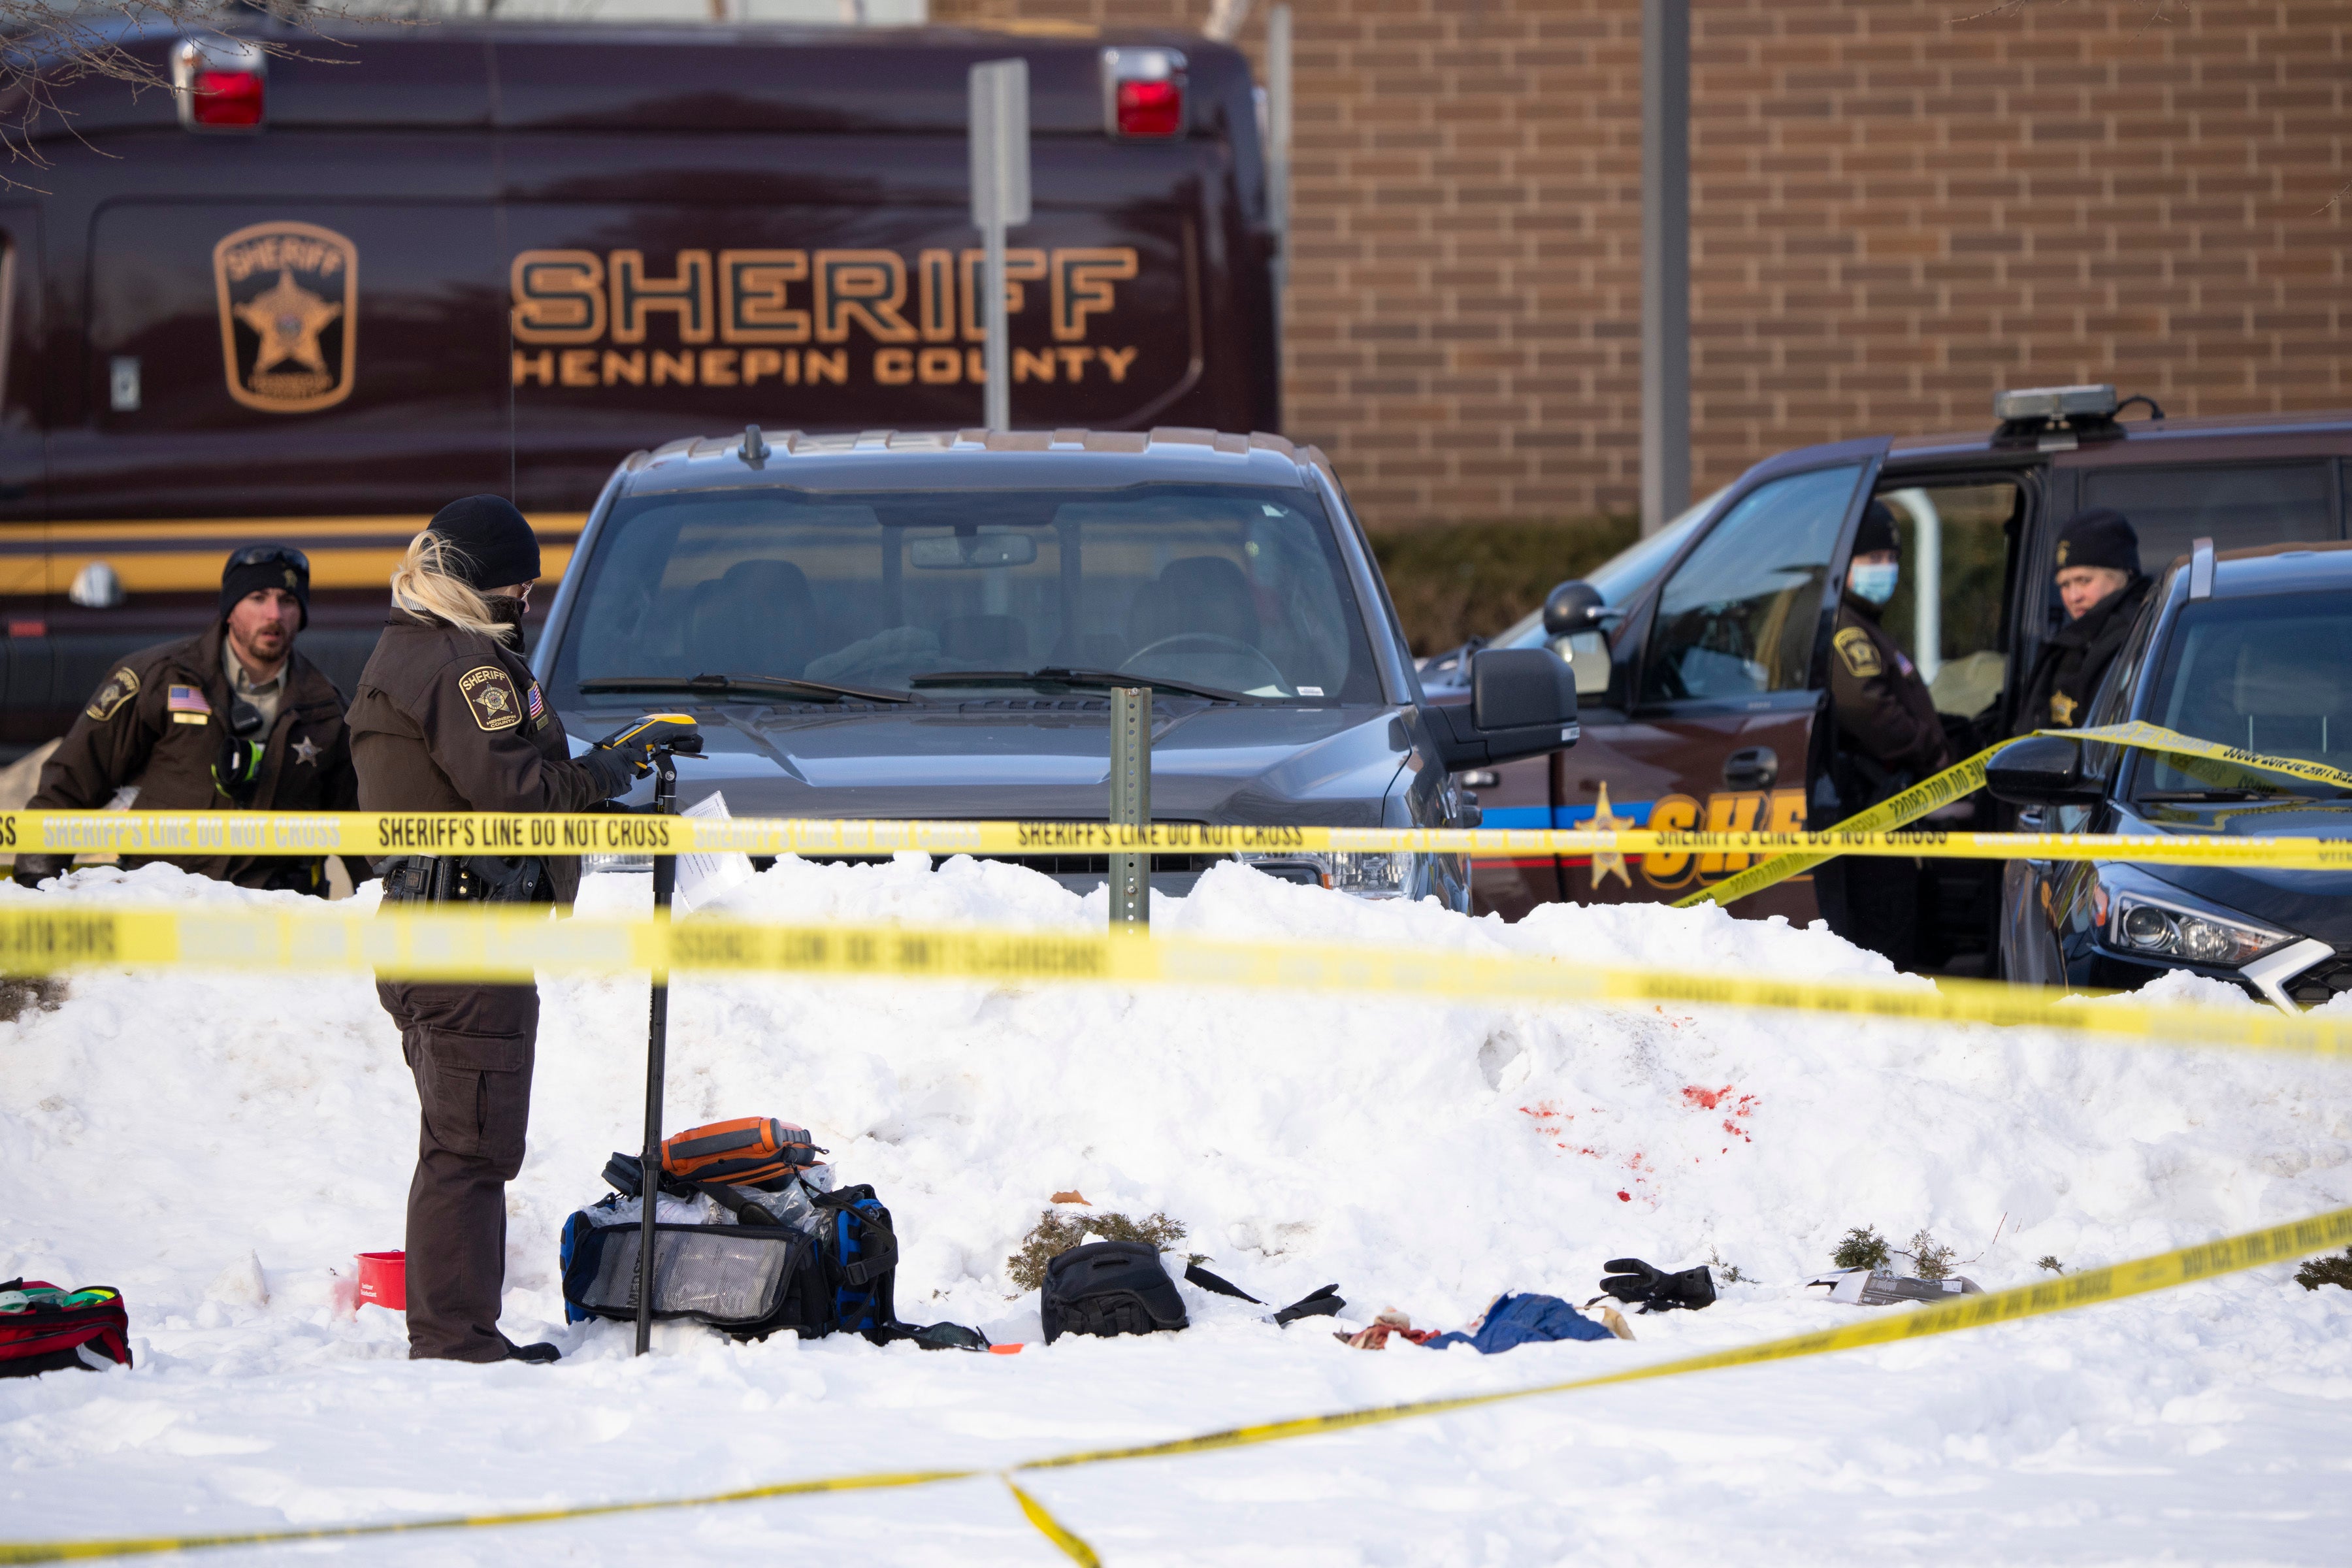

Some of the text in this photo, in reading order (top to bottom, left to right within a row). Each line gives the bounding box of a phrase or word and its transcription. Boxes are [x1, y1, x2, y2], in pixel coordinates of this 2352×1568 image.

[227, 237, 344, 282] SHERIFF
[510, 248, 1138, 344] SHERIFF
[512, 349, 848, 386] HENNEPIN
[463, 670, 506, 691] SHERIFF
[486, 714, 517, 726] HENNEPIN
[491, 719, 515, 728] COUNTY
[43, 817, 341, 848] SHERIFF'S LINE DO NOT CROSS
[379, 817, 670, 847] SHERIFF'S LINE DO NOT CROSS
[693, 821, 981, 848] SHERIFF'S LINE DO NOT CROSS
[1018, 823, 1304, 847] SHERIFF'S LINE DO NOT CROSS
[1841, 830, 1876, 847] NOT
